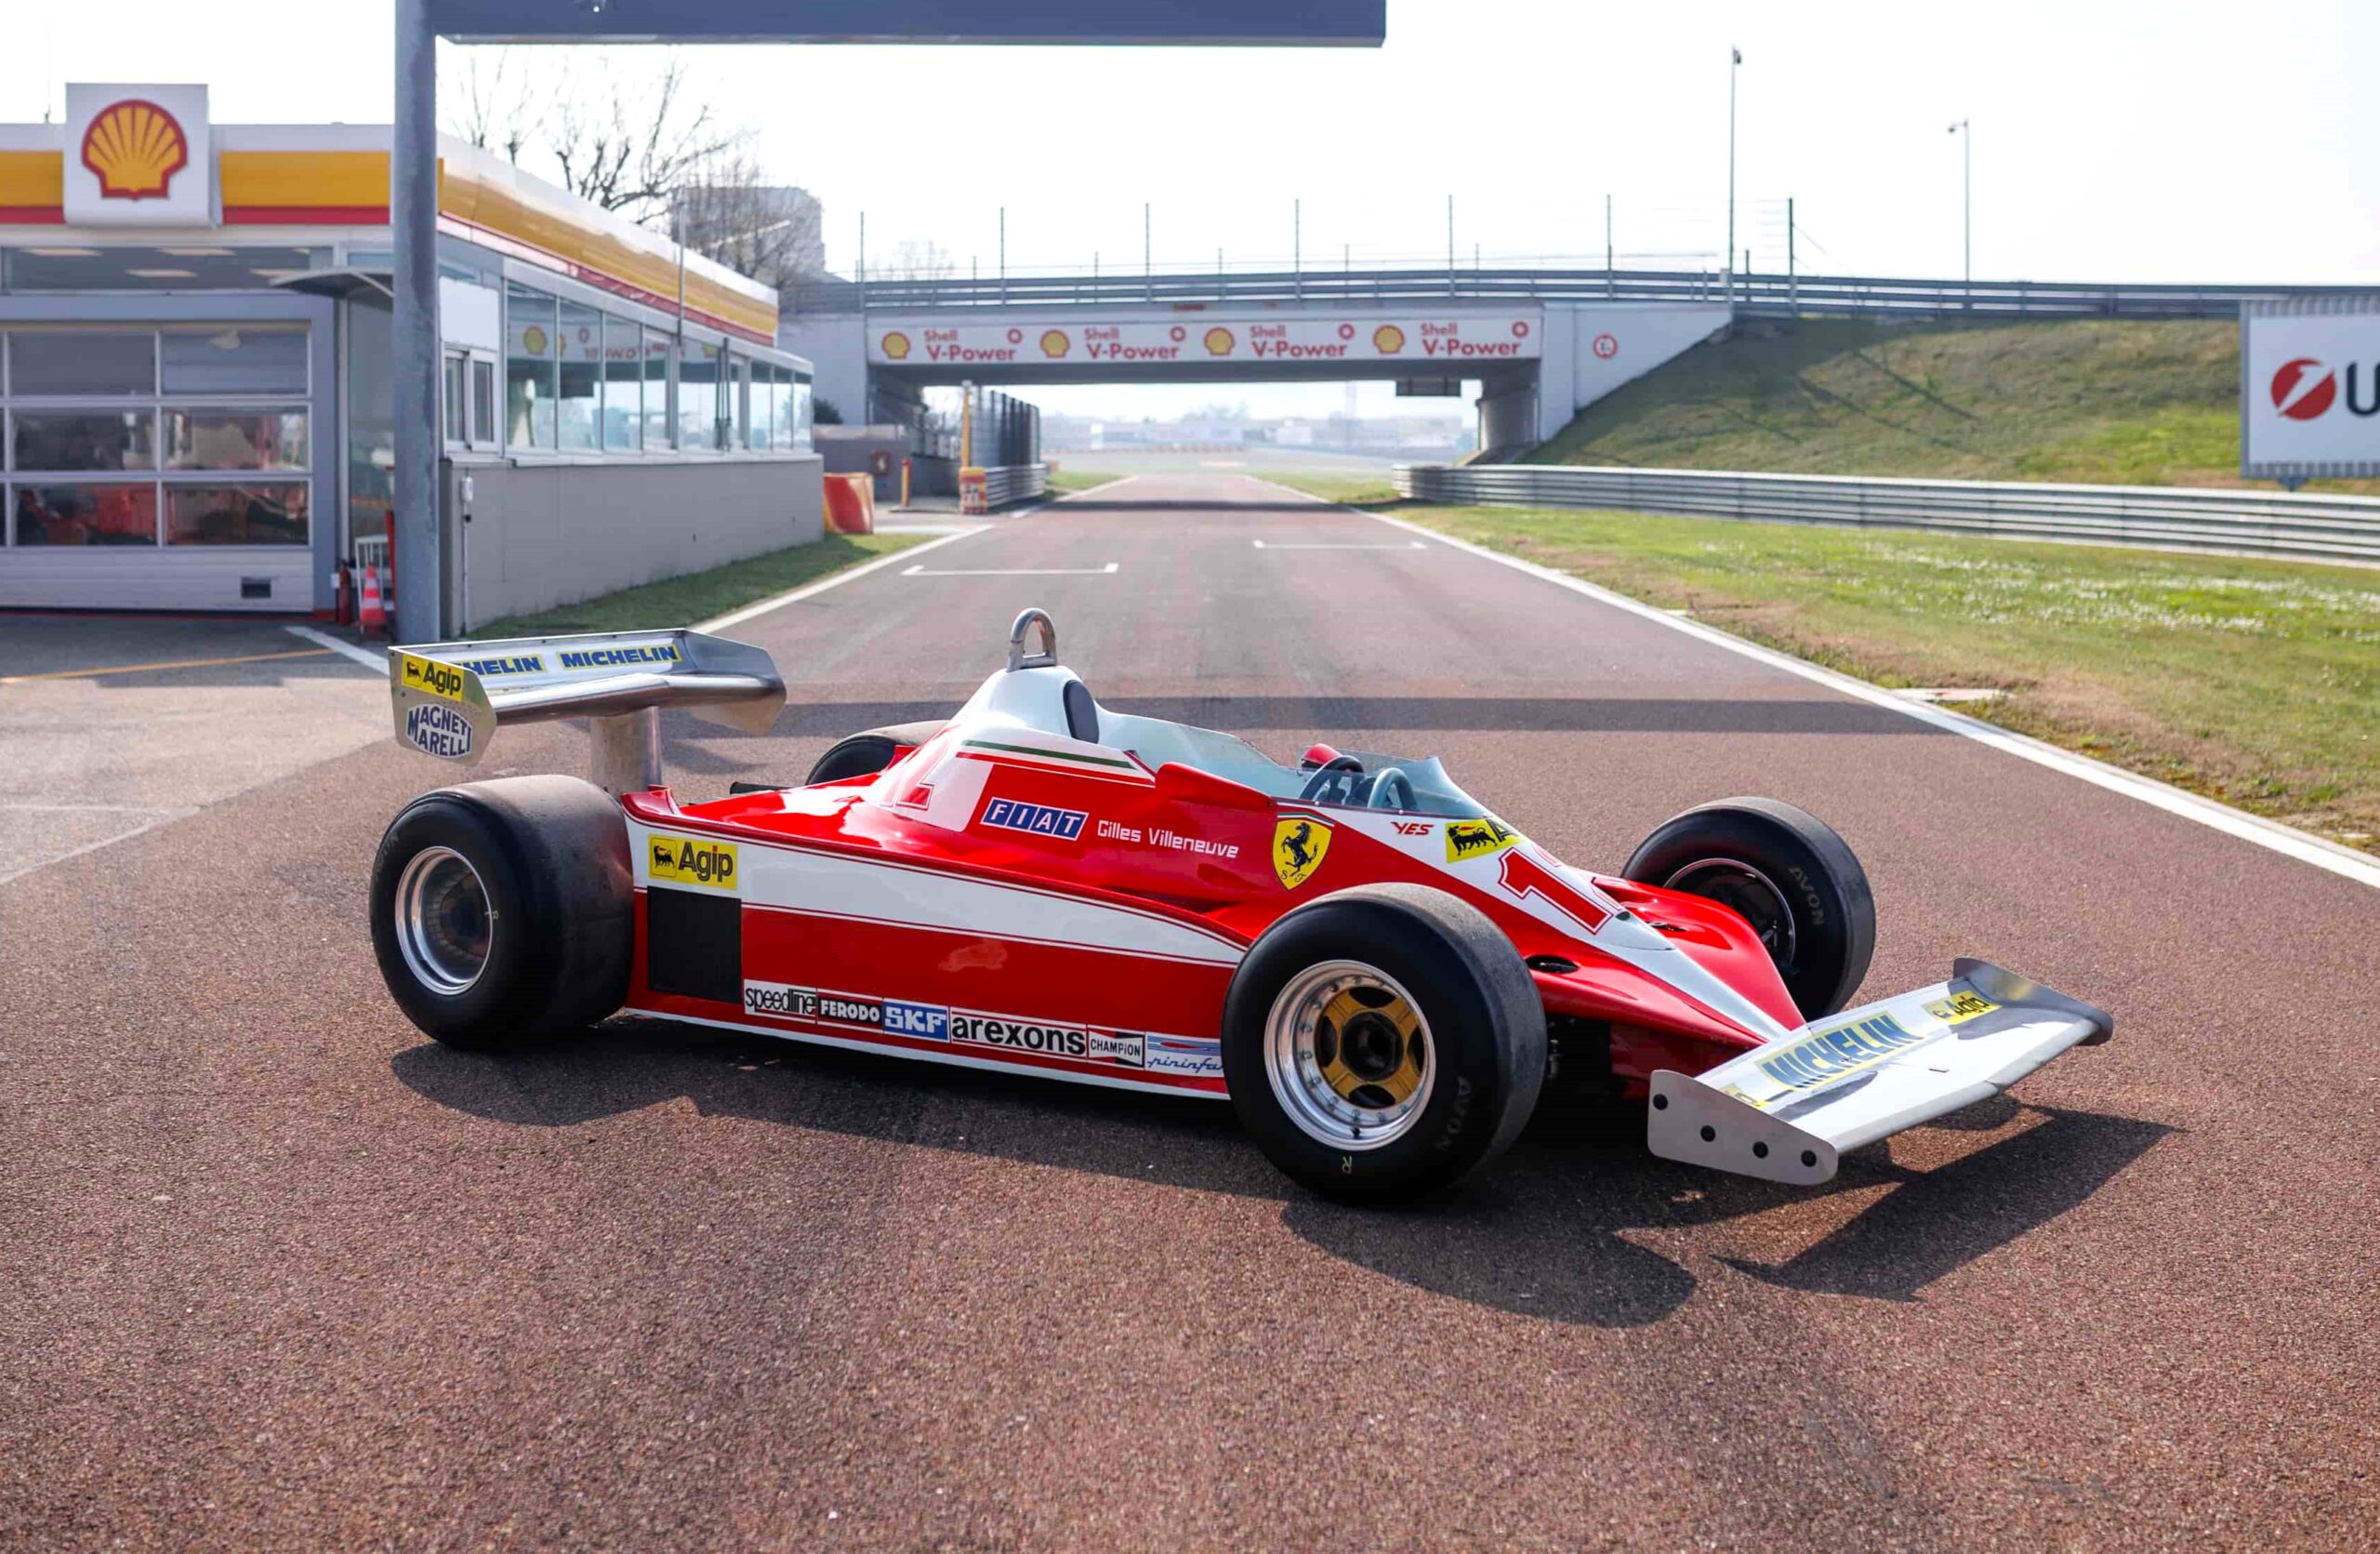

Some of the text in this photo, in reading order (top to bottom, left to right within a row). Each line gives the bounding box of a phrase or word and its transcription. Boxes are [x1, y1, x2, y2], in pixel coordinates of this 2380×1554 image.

[924, 329, 958, 341] Shell
[1085, 327, 1120, 340] Shell
[1250, 325, 1286, 339] Shell
[1421, 323, 1458, 337] Shell
[927, 345, 1016, 361] V-Power
[1086, 343, 1179, 359] V-Power
[1251, 340, 1348, 358] V-Power
[1422, 339, 1521, 356] V-Power
[453, 657, 542, 675] HELIN
[561, 644, 679, 668] MICHELIN
[423, 662, 462, 696] Agip
[407, 706, 471, 744] MAGNETI
[991, 803, 1079, 834] FIAT
[1390, 821, 1435, 835] YES
[1097, 820, 1239, 859] Gilles Villeneuve
[678, 841, 734, 883] Agip
[1498, 847, 1614, 936] 1
[1789, 866, 1824, 925] AVON
[746, 988, 816, 1015] speedline
[820, 1000, 880, 1023] FERODO
[885, 1006, 946, 1034] SKF
[951, 1016, 1086, 1056] arexons
[1763, 1015, 1923, 1088] MICHELIN
[1147, 1056, 1223, 1073] pininfa
